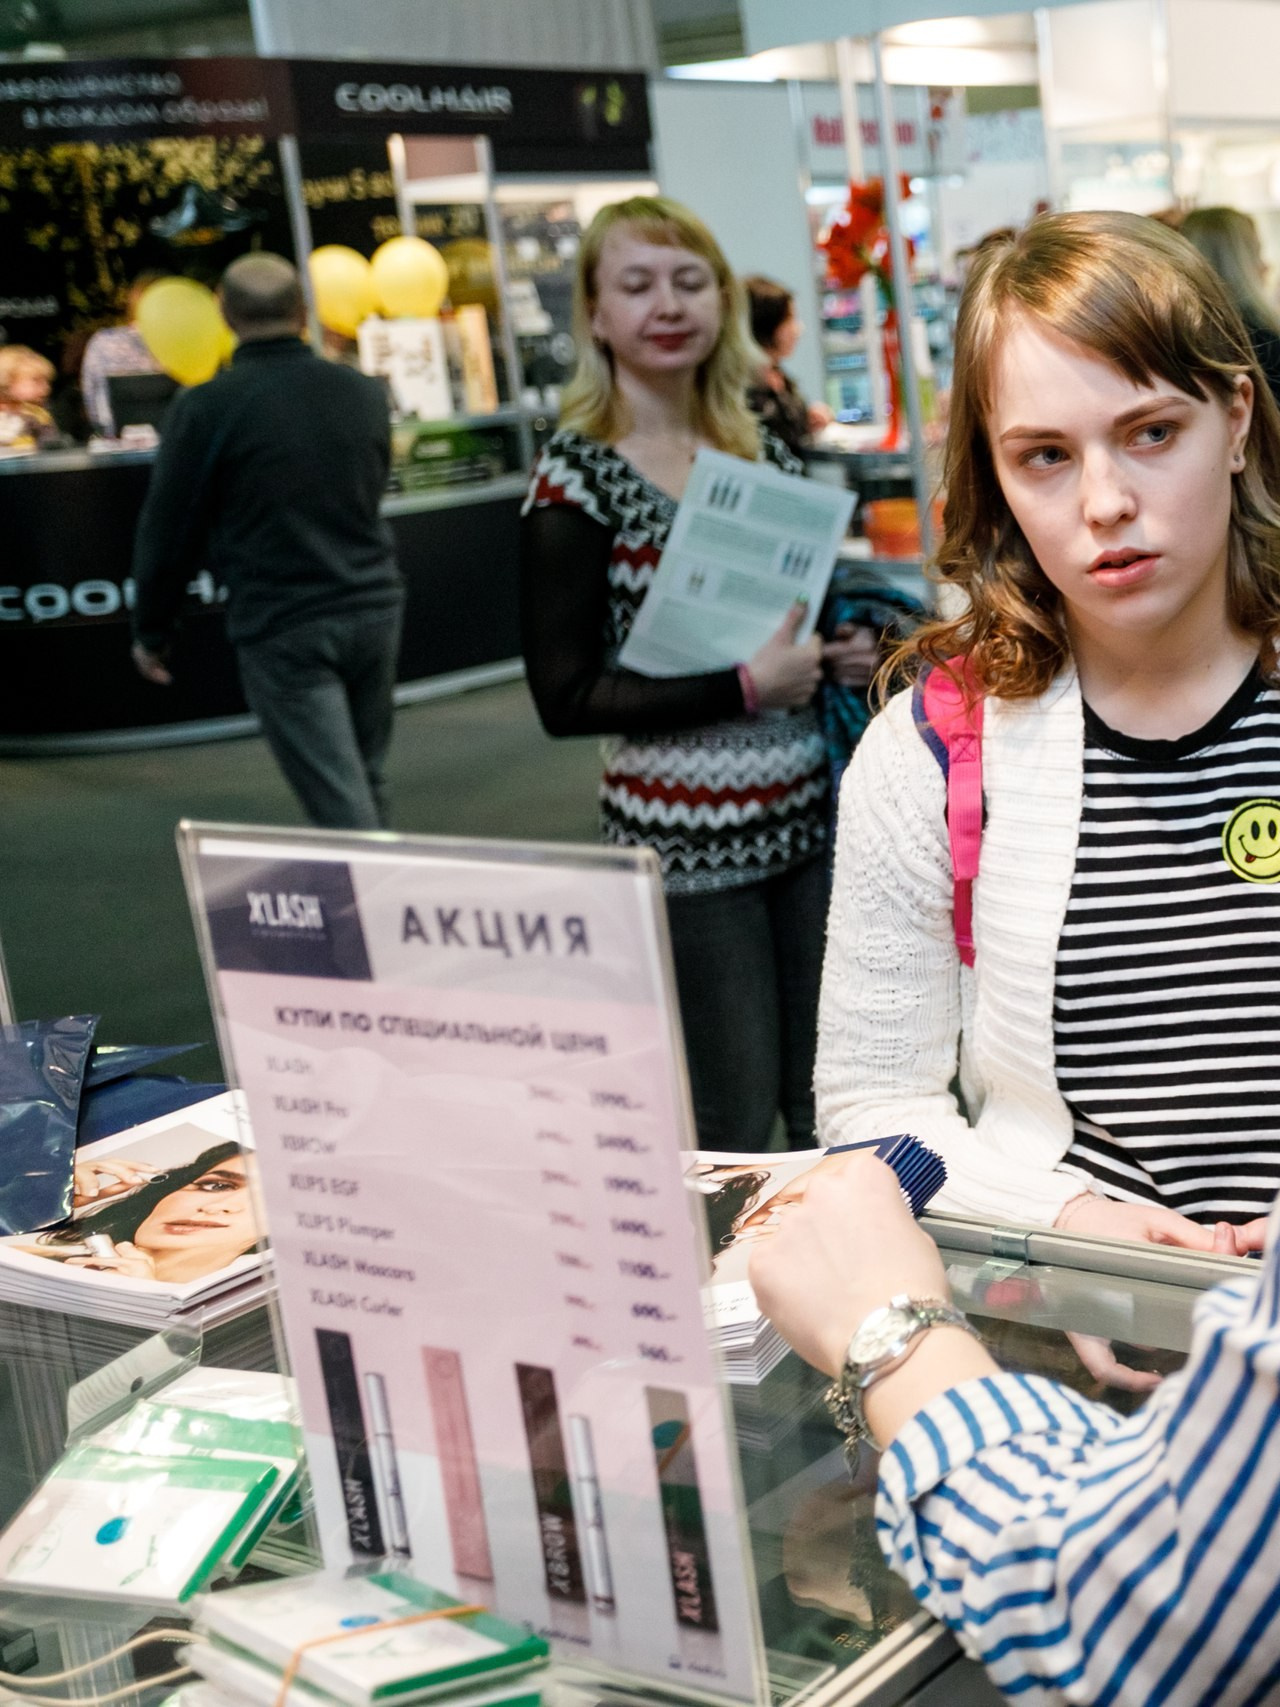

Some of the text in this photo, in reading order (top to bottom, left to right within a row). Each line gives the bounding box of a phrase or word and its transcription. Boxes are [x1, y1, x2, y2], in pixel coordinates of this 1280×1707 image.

[335, 82, 512, 114] COOLHAIR
[246, 890, 324, 929] XLASH
[402, 905, 589, 958] АКЦИЯ
[275, 1006, 335, 1029] КУПИ
[340, 1010, 373, 1034] ПО
[378, 1013, 545, 1049] СПЕЦИАЛЬНОЙ
[345, 1479, 371, 1548] XLASH
